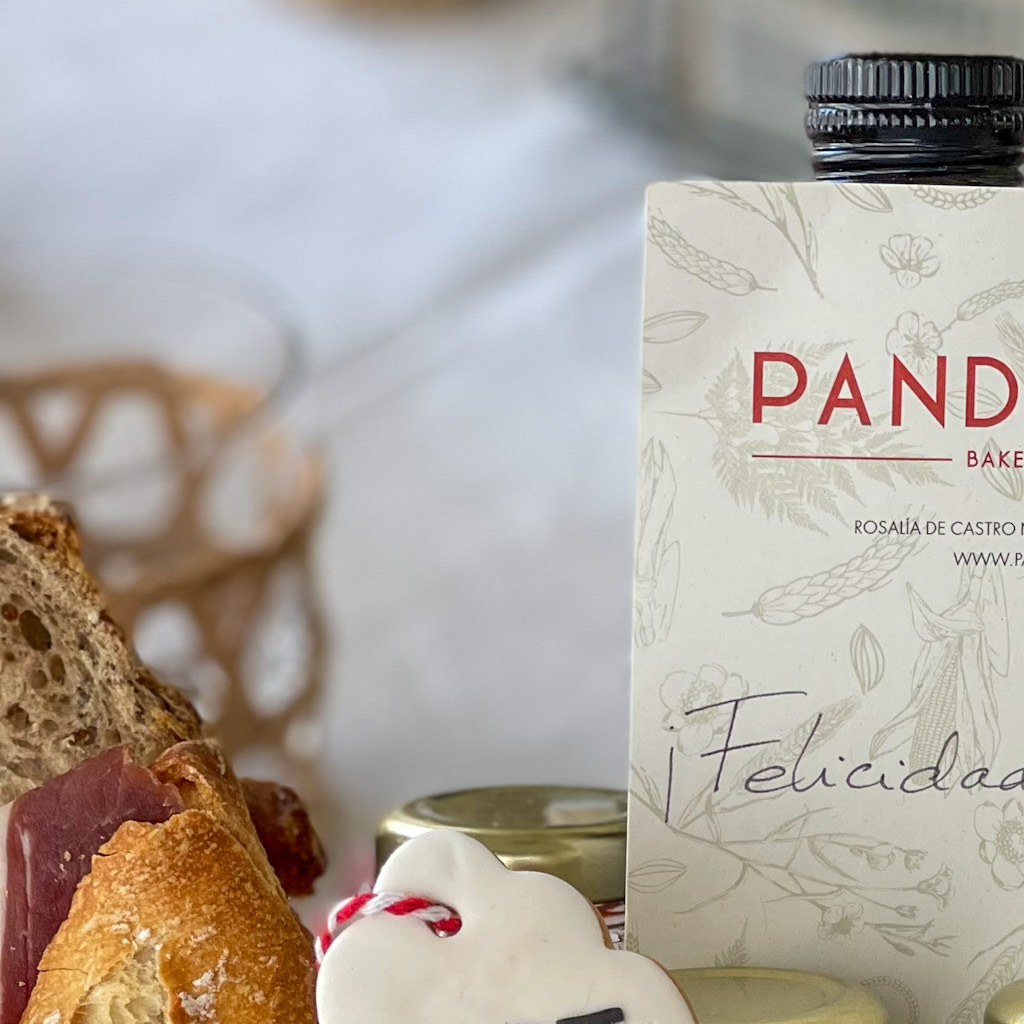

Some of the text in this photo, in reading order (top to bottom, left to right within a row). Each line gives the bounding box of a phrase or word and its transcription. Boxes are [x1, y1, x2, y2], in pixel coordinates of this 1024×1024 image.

[854, 517, 922, 536] ROSALÍA
[925, 521, 946, 536] DE
[950, 521, 1016, 537] CASTRO
